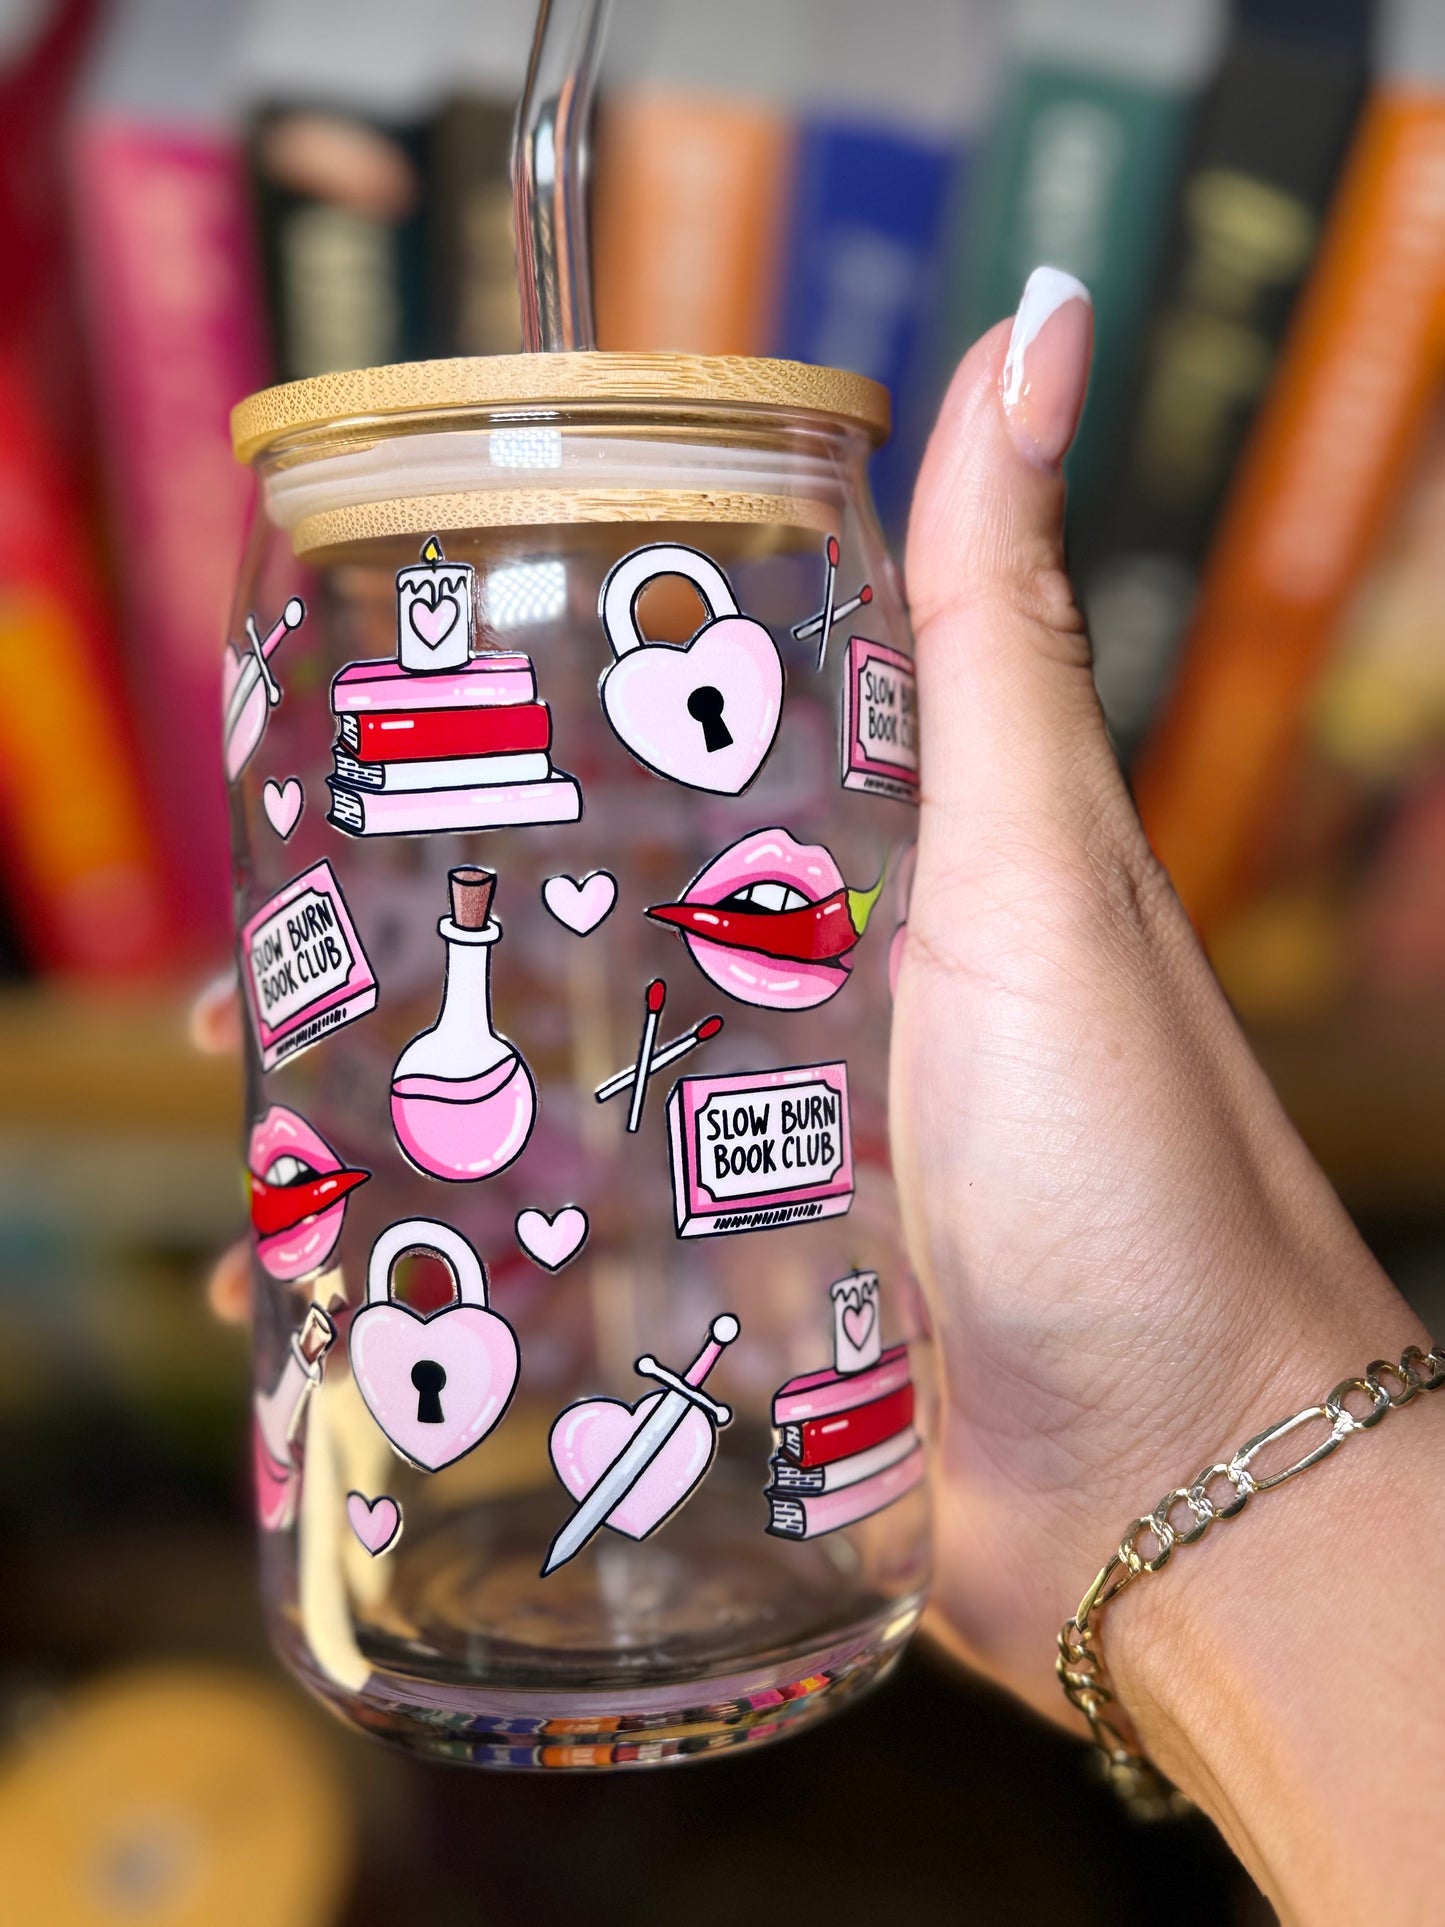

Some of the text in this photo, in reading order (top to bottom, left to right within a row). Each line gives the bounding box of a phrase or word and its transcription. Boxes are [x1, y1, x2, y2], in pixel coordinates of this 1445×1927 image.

[865, 671, 895, 707] SLOW
[252, 899, 334, 977] SLOW BURN
[260, 936, 343, 1010] BOOK CLUB
[707, 1095, 836, 1141] SLOW BURN
[714, 1132, 835, 1179] BOOK CLUB
